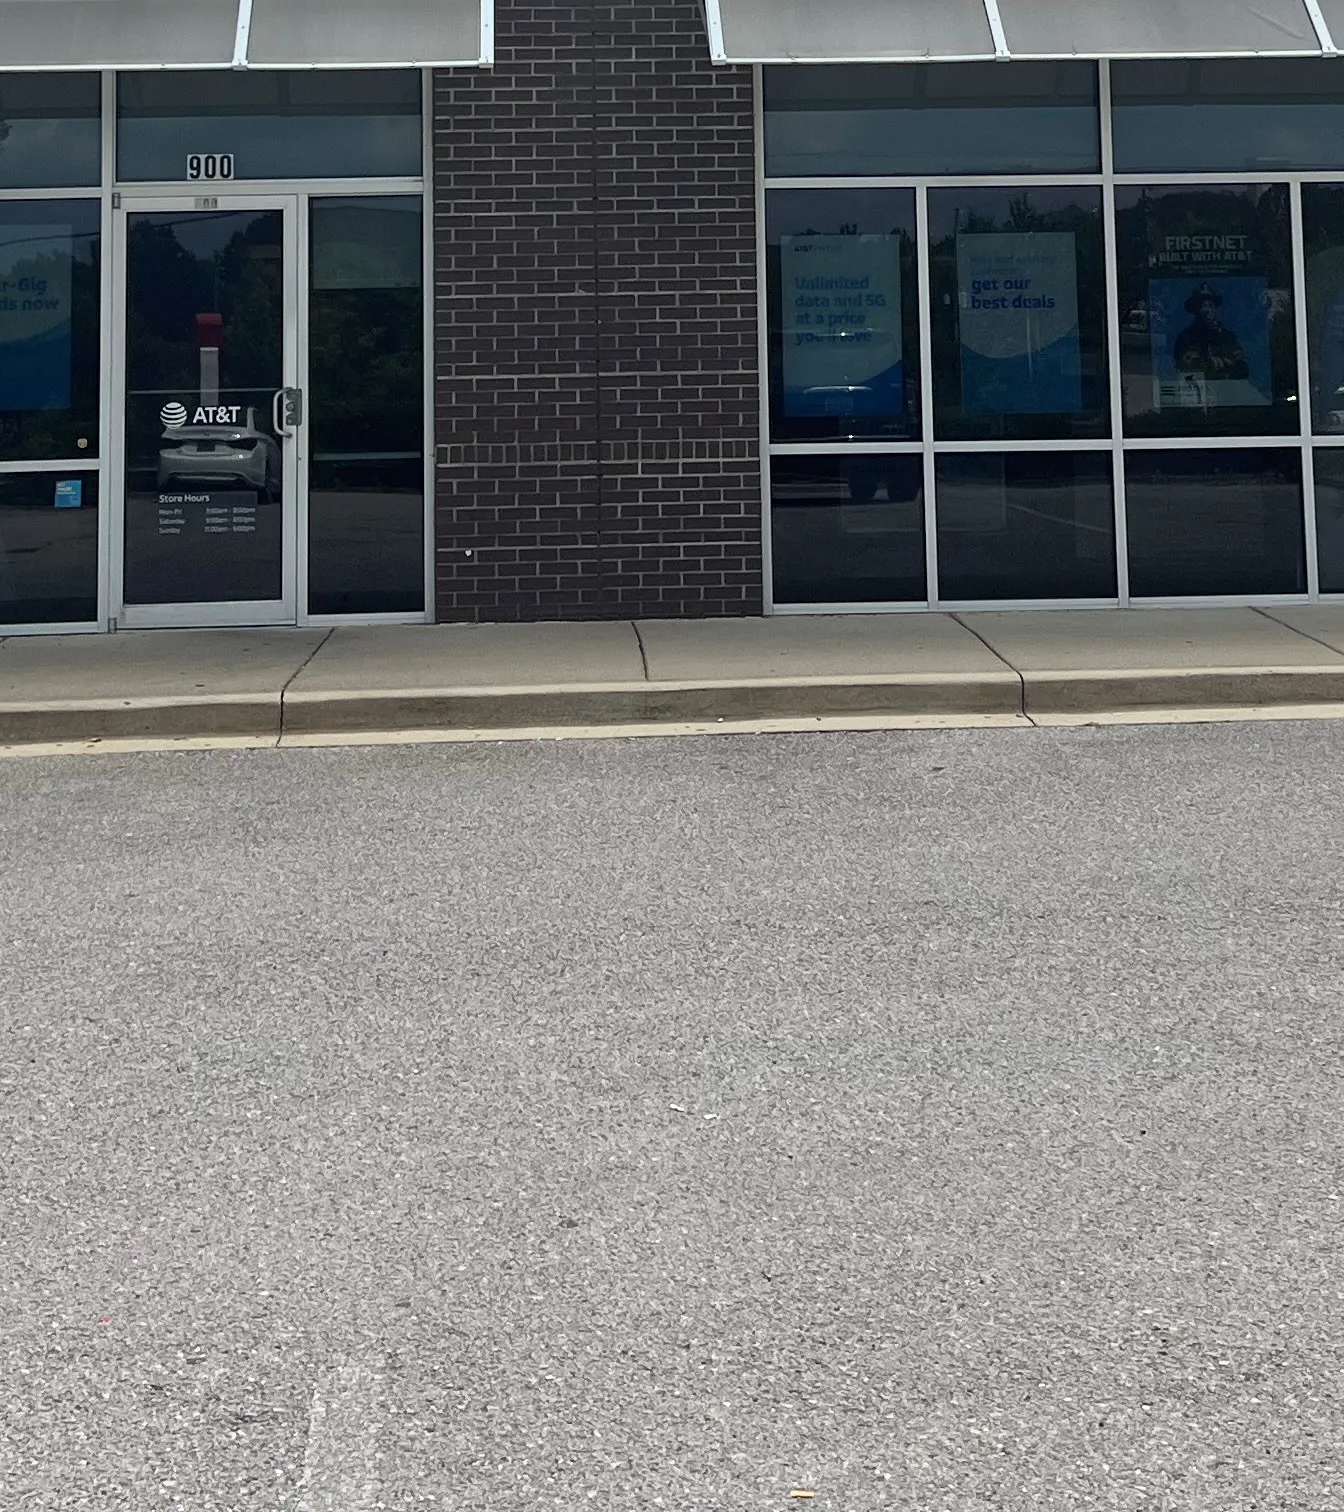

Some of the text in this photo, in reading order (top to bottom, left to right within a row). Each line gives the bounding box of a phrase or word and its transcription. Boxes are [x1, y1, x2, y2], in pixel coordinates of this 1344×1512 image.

[189, 155, 232, 179] 900
[1164, 235, 1248, 251] FIRSTNET
[1192, 251, 1221, 261] WITH
[1224, 250, 1253, 261] AT&T
[794, 276, 869, 290] Unlimited
[971, 279, 1031, 295] get our
[22, 299, 60, 310] now
[794, 293, 887, 307] data and 5G
[971, 294, 1056, 309] best deals
[795, 311, 866, 327] at a price
[192, 406, 242, 424] AT&T
[159, 494, 210, 503] Store Hours
